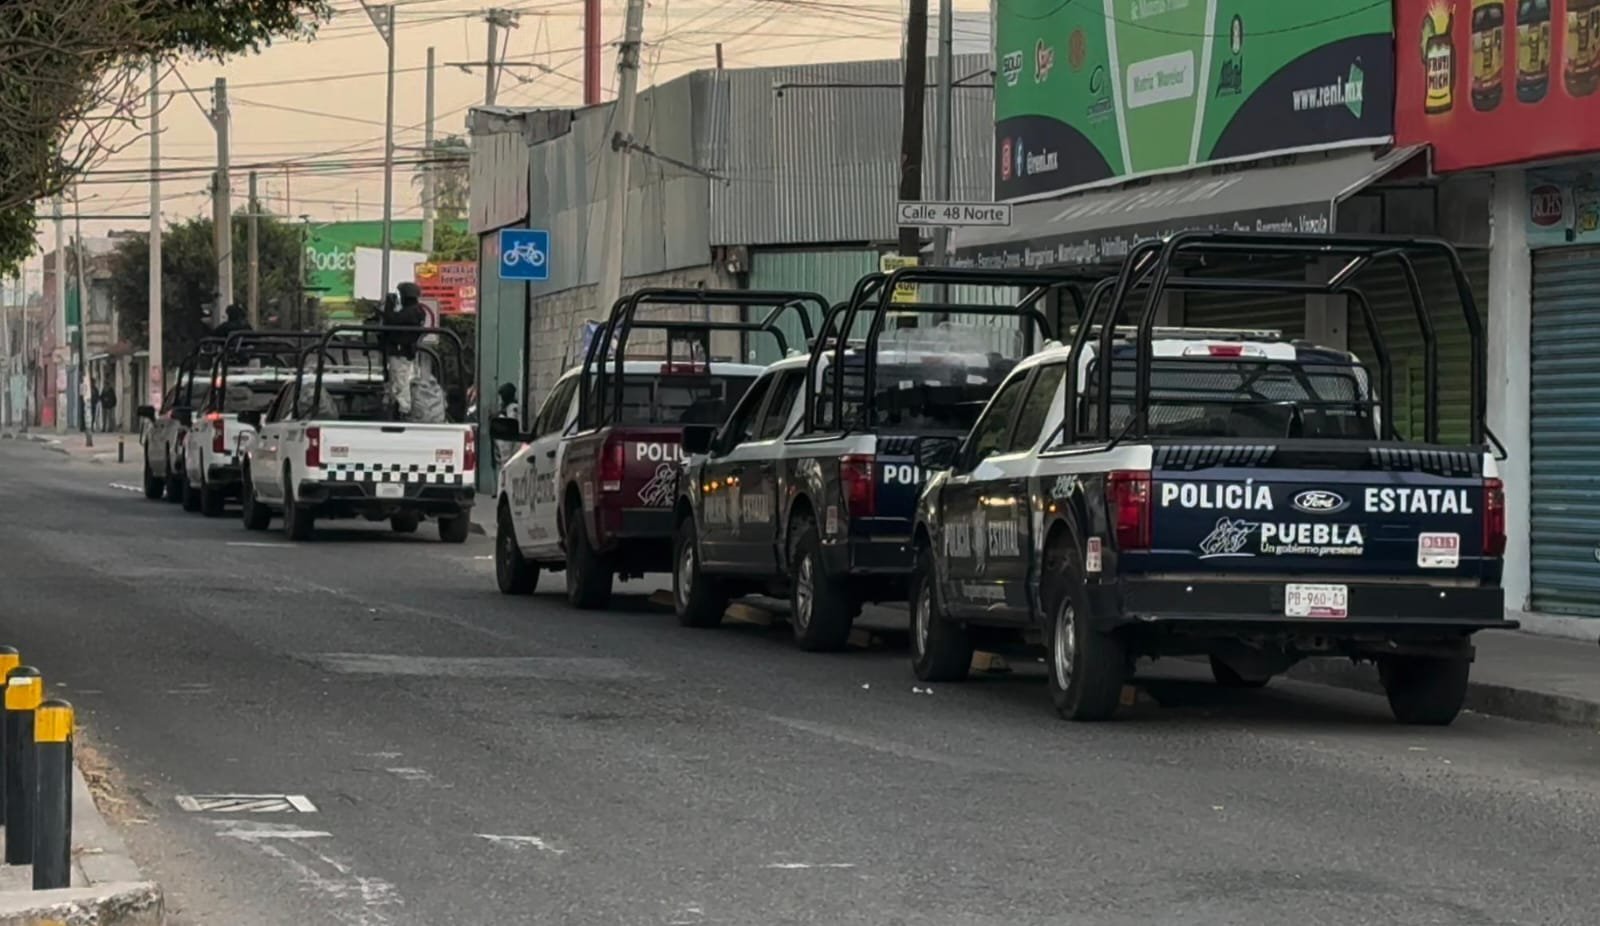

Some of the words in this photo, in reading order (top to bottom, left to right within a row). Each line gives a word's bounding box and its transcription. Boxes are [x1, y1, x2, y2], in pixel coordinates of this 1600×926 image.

[1428, 73, 1449, 90] MICH
[1292, 75, 1364, 111] www.reni.mx
[902, 205, 936, 219] Calle
[943, 206, 960, 220] 48
[964, 207, 1004, 221] Norte
[1161, 479, 1274, 511] POLICÍA
[1303, 494, 1334, 508] Ford
[1364, 487, 1473, 514] ESTATAL
[1260, 523, 1365, 545] PUEBLA
[1260, 543, 1275, 553] Un
[1276, 543, 1319, 555] gobierno
[1319, 545, 1364, 556] presente
